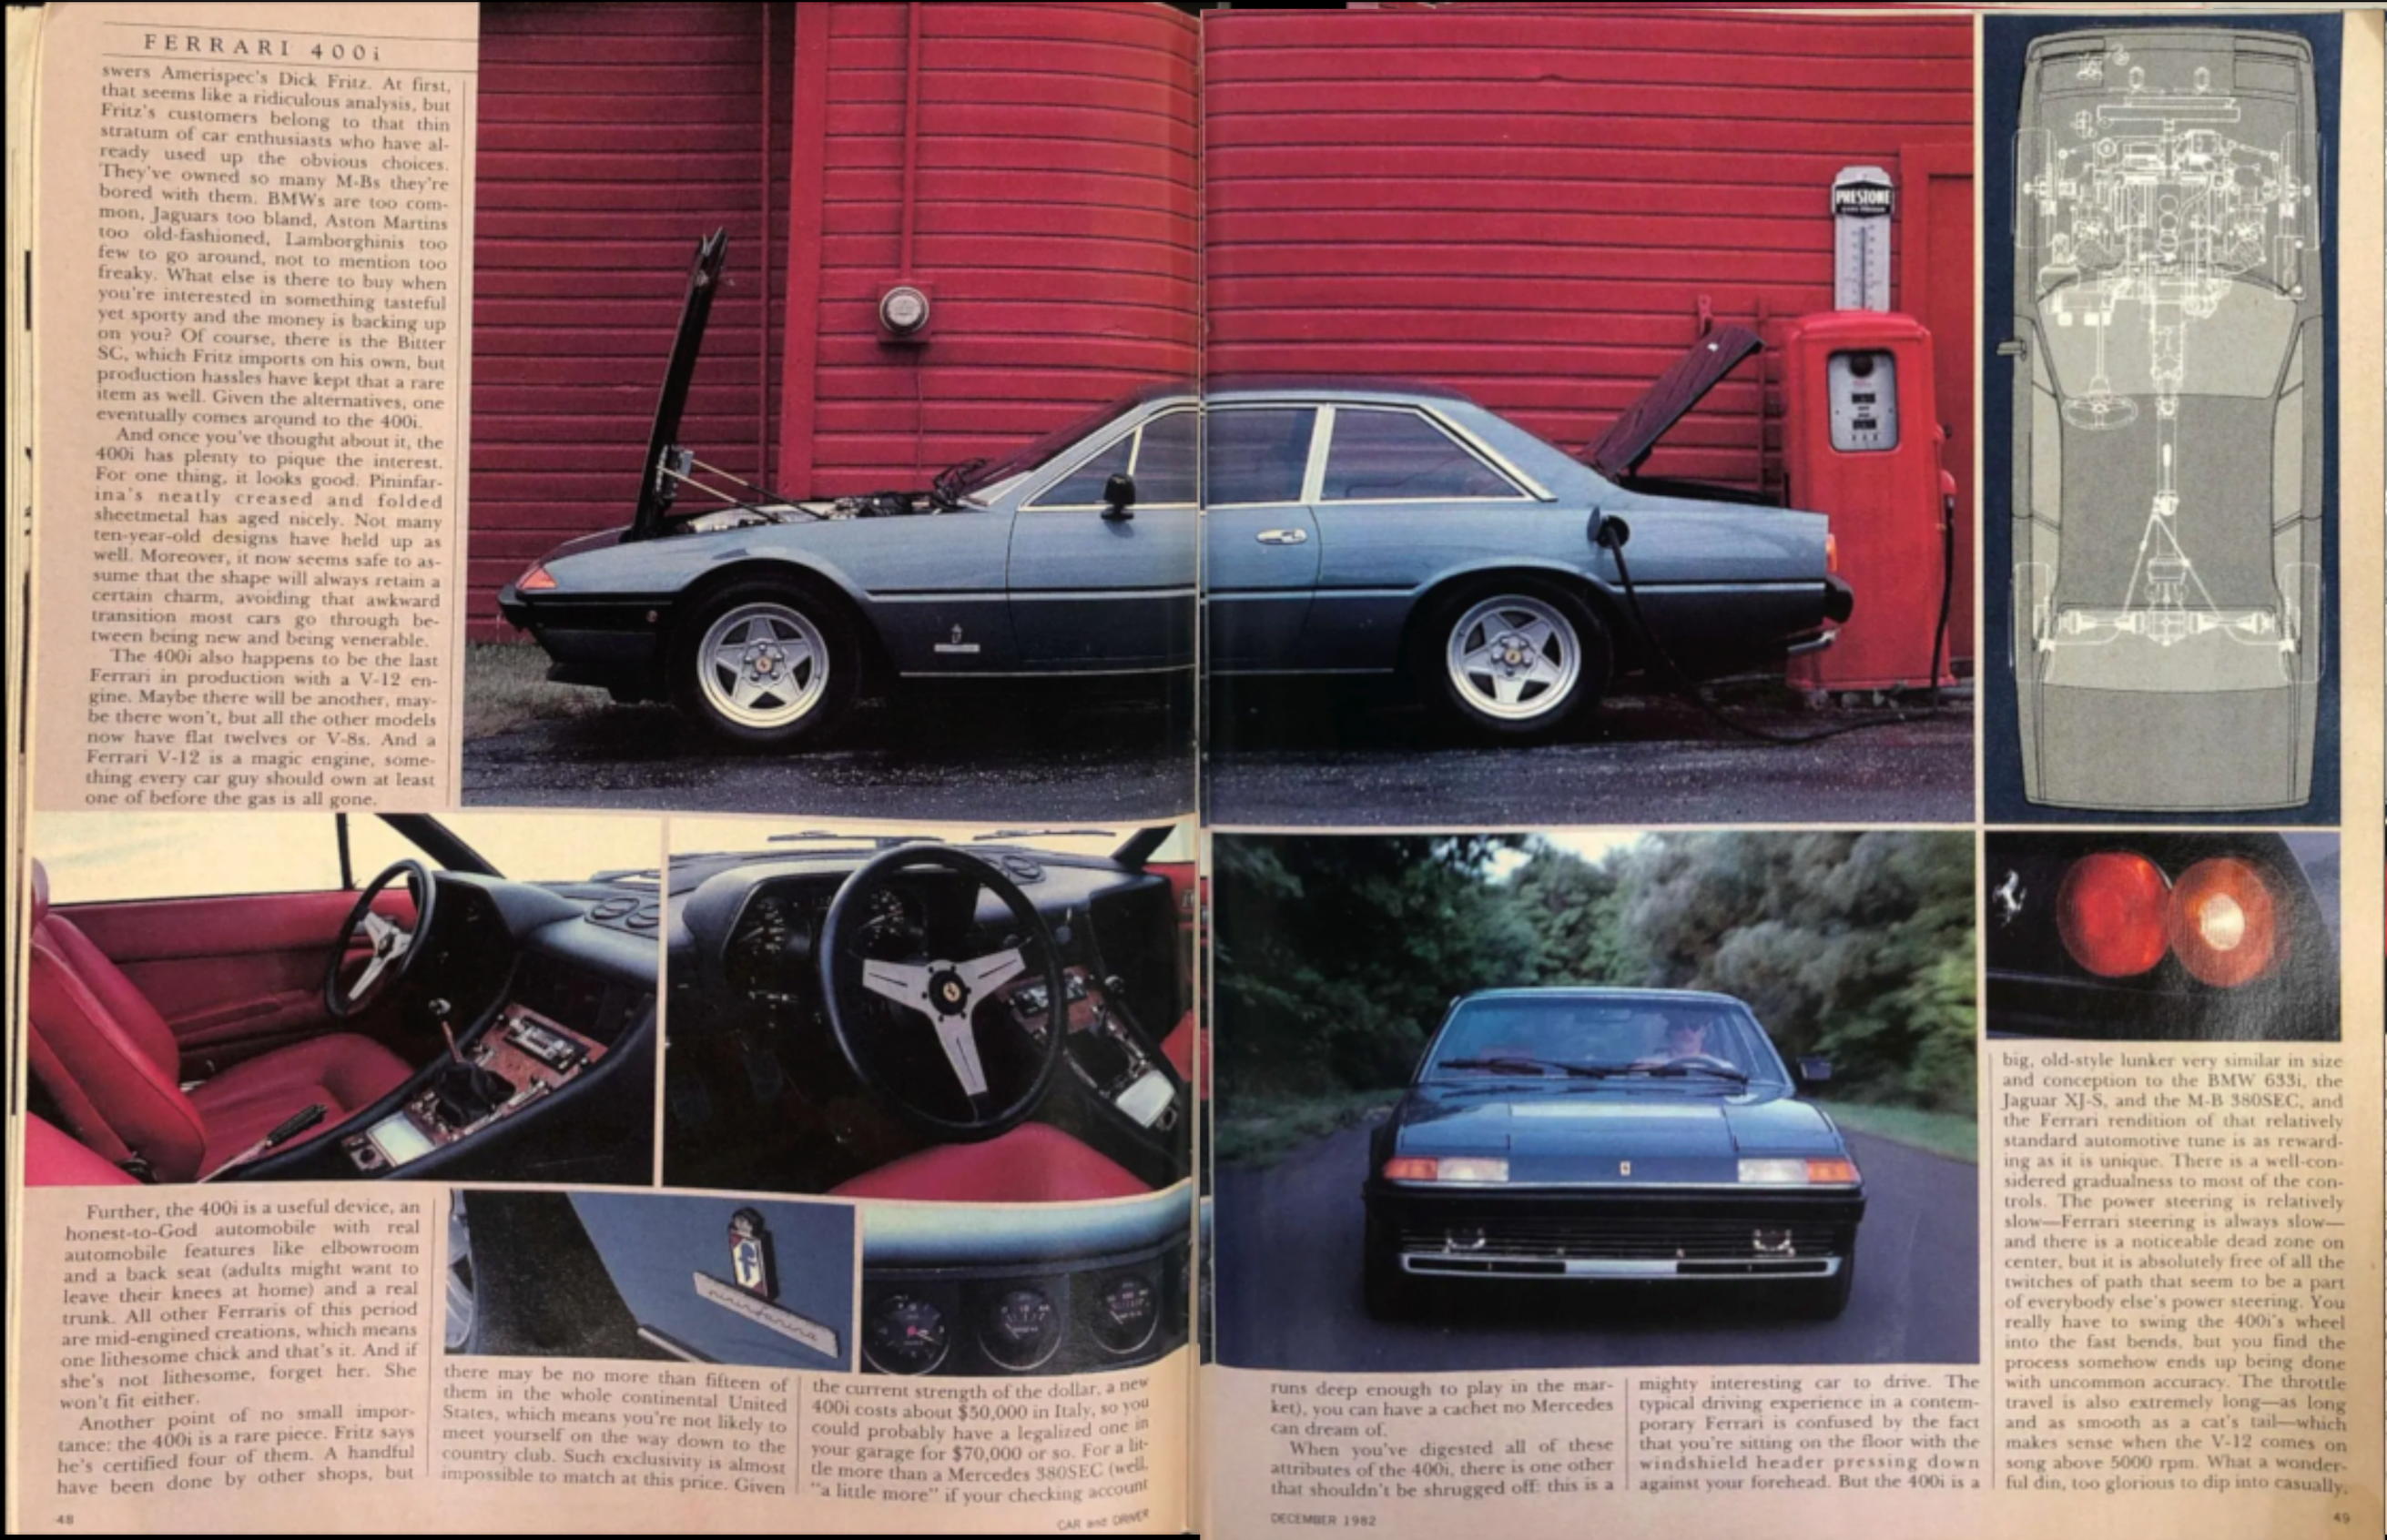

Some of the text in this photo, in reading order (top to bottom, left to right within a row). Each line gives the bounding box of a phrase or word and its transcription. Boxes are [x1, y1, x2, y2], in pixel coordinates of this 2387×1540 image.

[144, 33, 381, 62] FERRARI 400i
[101, 64, 451, 94] swers Amerispec's Dick Fritz. At first,
[100, 100, 451, 131] Fritz's customers belong to that thin
[1835, 189, 1891, 205] PRESTONE
[97, 205, 448, 230] mon, Jaguars too bland, Aston Martins
[97, 225, 448, 253] too old-fashioned, Lamborghinis too
[94, 486, 442, 508] ina's neatly creased and folded
[93, 525, 442, 552] ten-year-old designs have held up as
[88, 665, 438, 688] Ferrari in production with a V-12 en-
[2002, 1072, 2035, 1088] and
[2042, 1070, 2138, 1090] conception
[2145, 1073, 2164, 1086] to
[2170, 1070, 2199, 1086] the
[2207, 1070, 2256, 1086] BMW
[2315, 1071, 2343, 1087] the
[2000, 1091, 2057, 1111] Jaguar
[2115, 1090, 2147, 1107] and
[2153, 1090, 2180, 1106] the
[2187, 1090, 2224, 1106] M-B
[2311, 1091, 2343, 1108] and
[2003, 1131, 2343, 1148] standard automotive tune is as reward-
[65, 1216, 420, 1241] honest-to-God automobile with real
[64, 1238, 419, 1261] automobile features like elbowroom
[61, 1299, 418, 1325] trunk. All other Ferraris of this period
[2004, 1292, 2346, 1312] of everybody else's power steering. You
[1638, 1372, 1980, 1393] mighty interesting car to drive. The
[59, 1388, 199, 1410] won't fit either.
[442, 1383, 787, 1412] them in the whole continental United
[811, 1396, 1149, 1421] 400i costs about $50,000 in Italy, so you
[1312, 1405, 1344, 1420] you
[1347, 1405, 1378, 1416] can
[1382, 1400, 1423, 1416] have
[1427, 1404, 1437, 1415] a
[1442, 1399, 1498, 1415] cachet
[1502, 1403, 1526, 1414] no
[1531, 1395, 1613, 1413] Mercedes
[1639, 1393, 1979, 1413] typical driving experience in a contem-
[1269, 1420, 1386, 1435] can dream of.
[441, 1444, 786, 1474] country club. Such exclusivity is almost
[810, 1458, 833, 1475] tle
[837, 1465, 884, 1479] more
[888, 1464, 928, 1481] than
[931, 1470, 942, 1481] a
[947, 1464, 1031, 1481] Mercedes
[1639, 1453, 1979, 1473] windshield header pressing down
[56, 1515, 75, 1525] 48
[1057, 1508, 1150, 1531] CAR and DRIVER
[1270, 1512, 1377, 1527] DECEMBER 1982
[2333, 1512, 2351, 1525] 49
